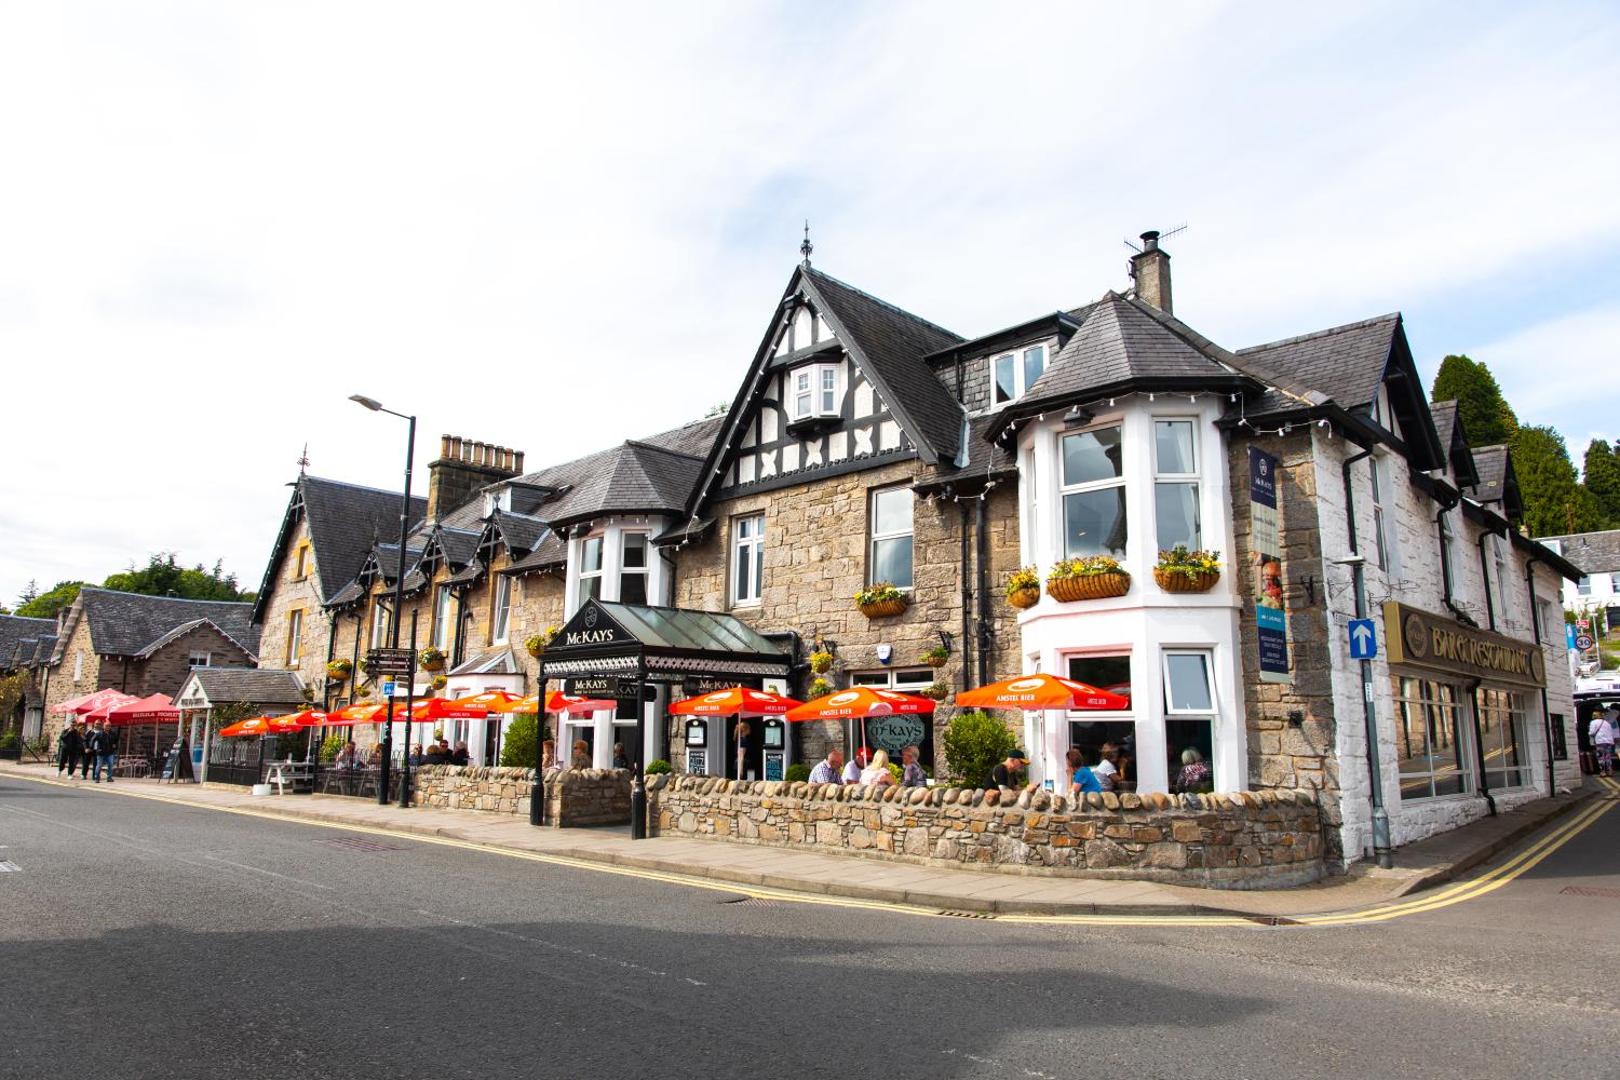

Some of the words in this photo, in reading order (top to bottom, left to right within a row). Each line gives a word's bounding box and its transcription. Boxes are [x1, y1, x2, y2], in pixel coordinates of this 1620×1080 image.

[566, 629, 613, 645] McKAYS
[1432, 627, 1457, 661] BAR
[1470, 639, 1529, 674] RESTAURANT
[575, 680, 607, 689] McKAYS
[699, 681, 736, 689] McKAY
